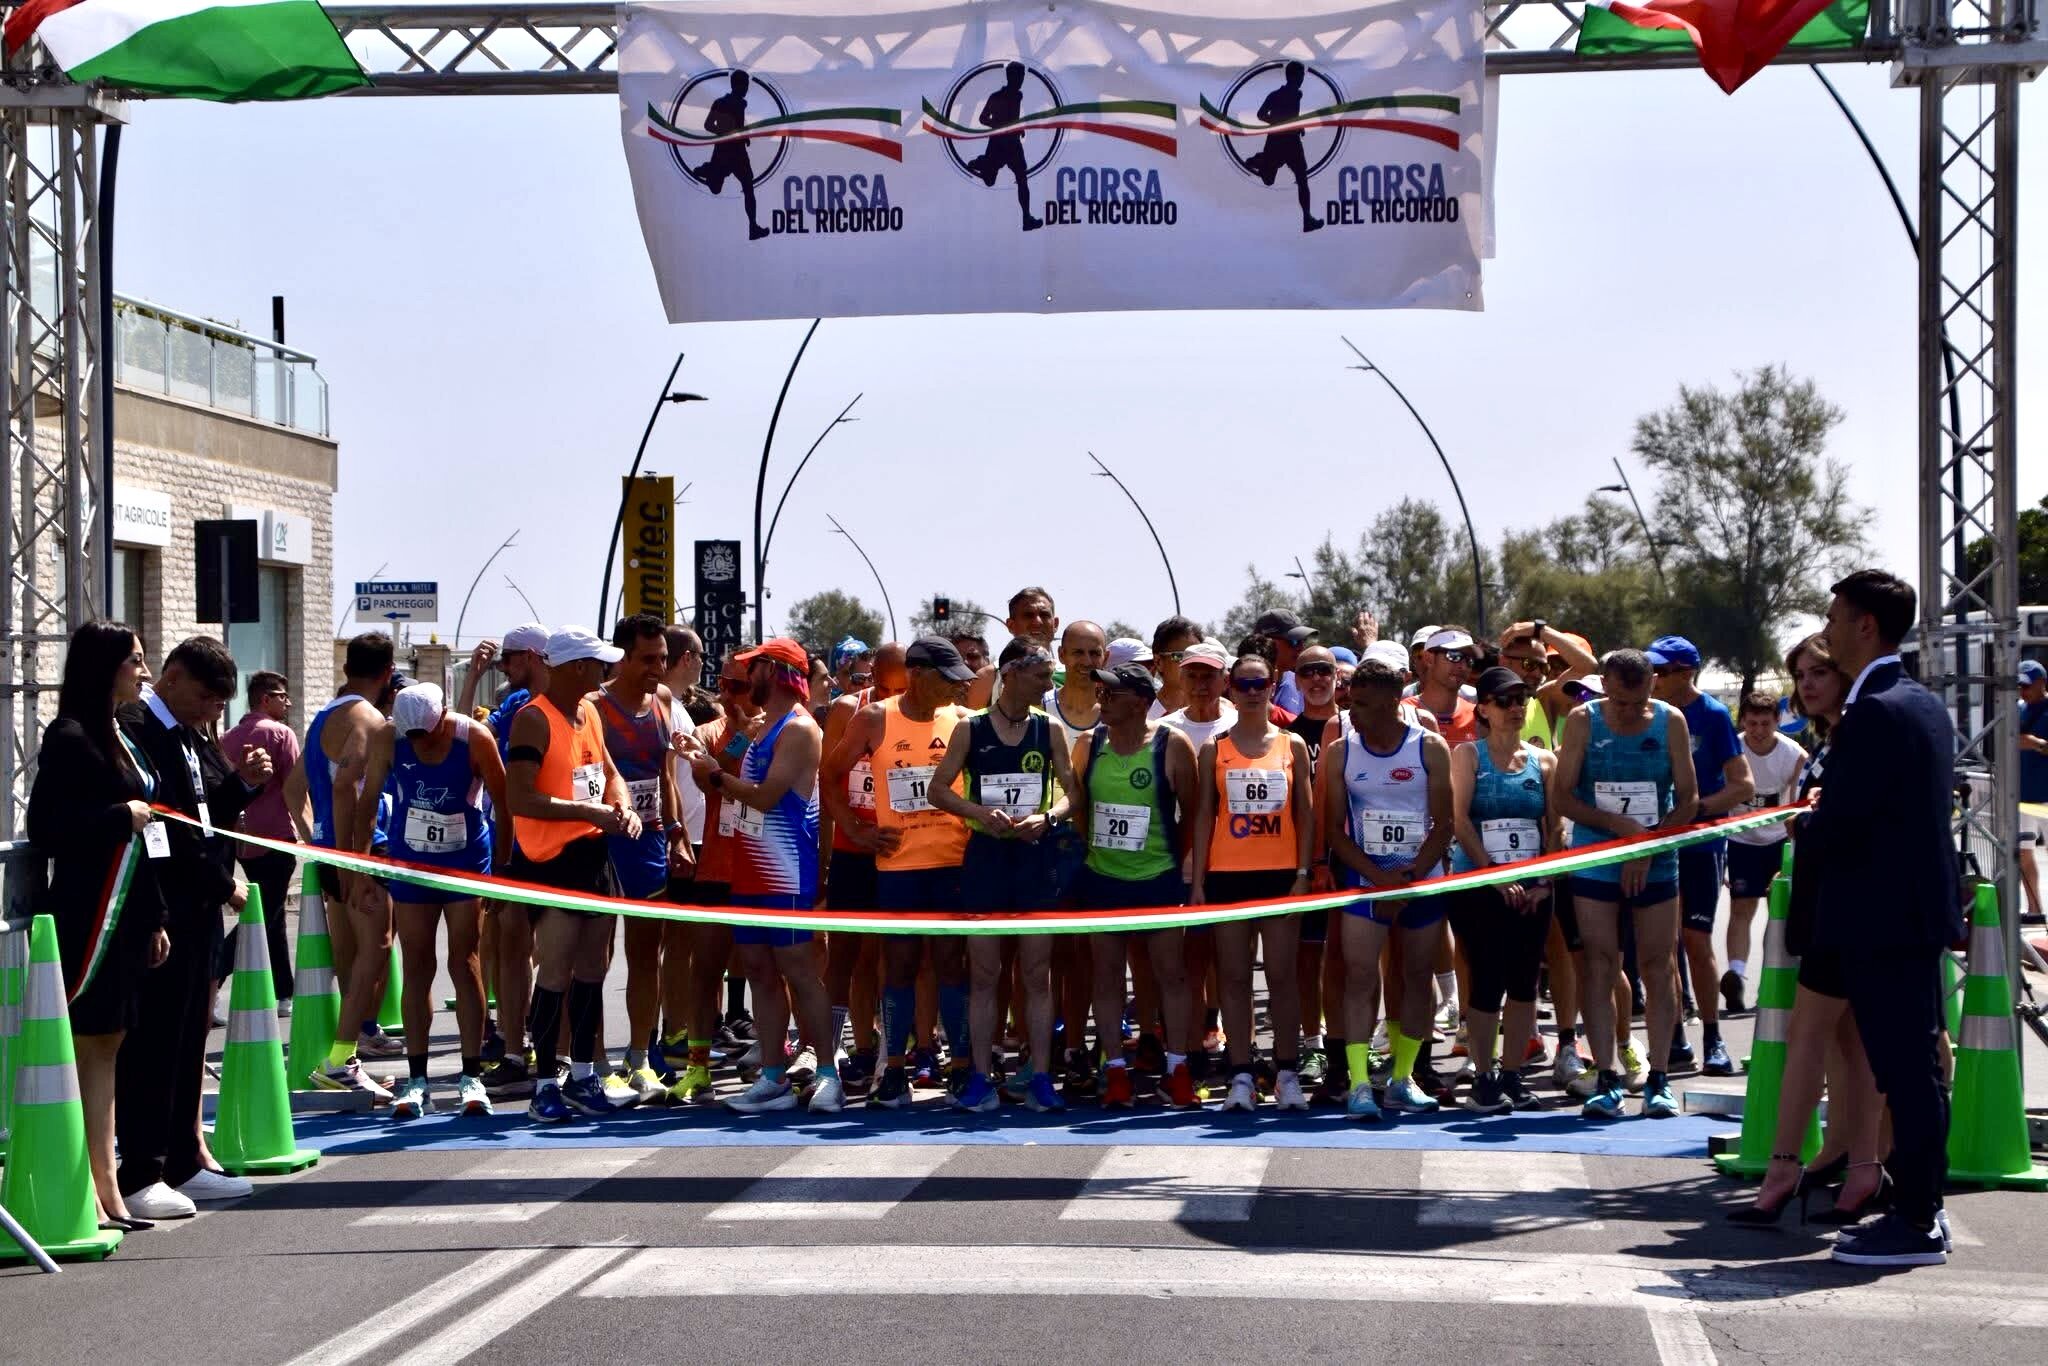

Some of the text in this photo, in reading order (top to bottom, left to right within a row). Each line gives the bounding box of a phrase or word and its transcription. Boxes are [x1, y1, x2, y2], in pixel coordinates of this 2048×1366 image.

[1055, 166, 1163, 206] CORSA
[1338, 163, 1446, 206] CORSA
[783, 174, 890, 215] CORSA
[772, 206, 903, 234] DEL RICORDO
[1045, 200, 1178, 226] DEL RICORDO
[1326, 196, 1459, 226] DEL RICORDO
[124, 505, 167, 528] AGRICOLE
[372, 583, 408, 592] PLAZA
[373, 599, 434, 609] PARCHEGGIO
[721, 603, 736, 660] CAF
[863, 777, 873, 792] 6
[910, 781, 925, 798] 11
[1246, 783, 1268, 800] 66
[636, 793, 653, 811] 22
[1004, 788, 1021, 805] 17
[1620, 797, 1631, 814] 7
[427, 825, 444, 843] 61
[1109, 819, 1128, 836] 20
[1230, 813, 1281, 839] QSM
[1383, 825, 1405, 842] 60
[1509, 832, 1520, 849] 9
